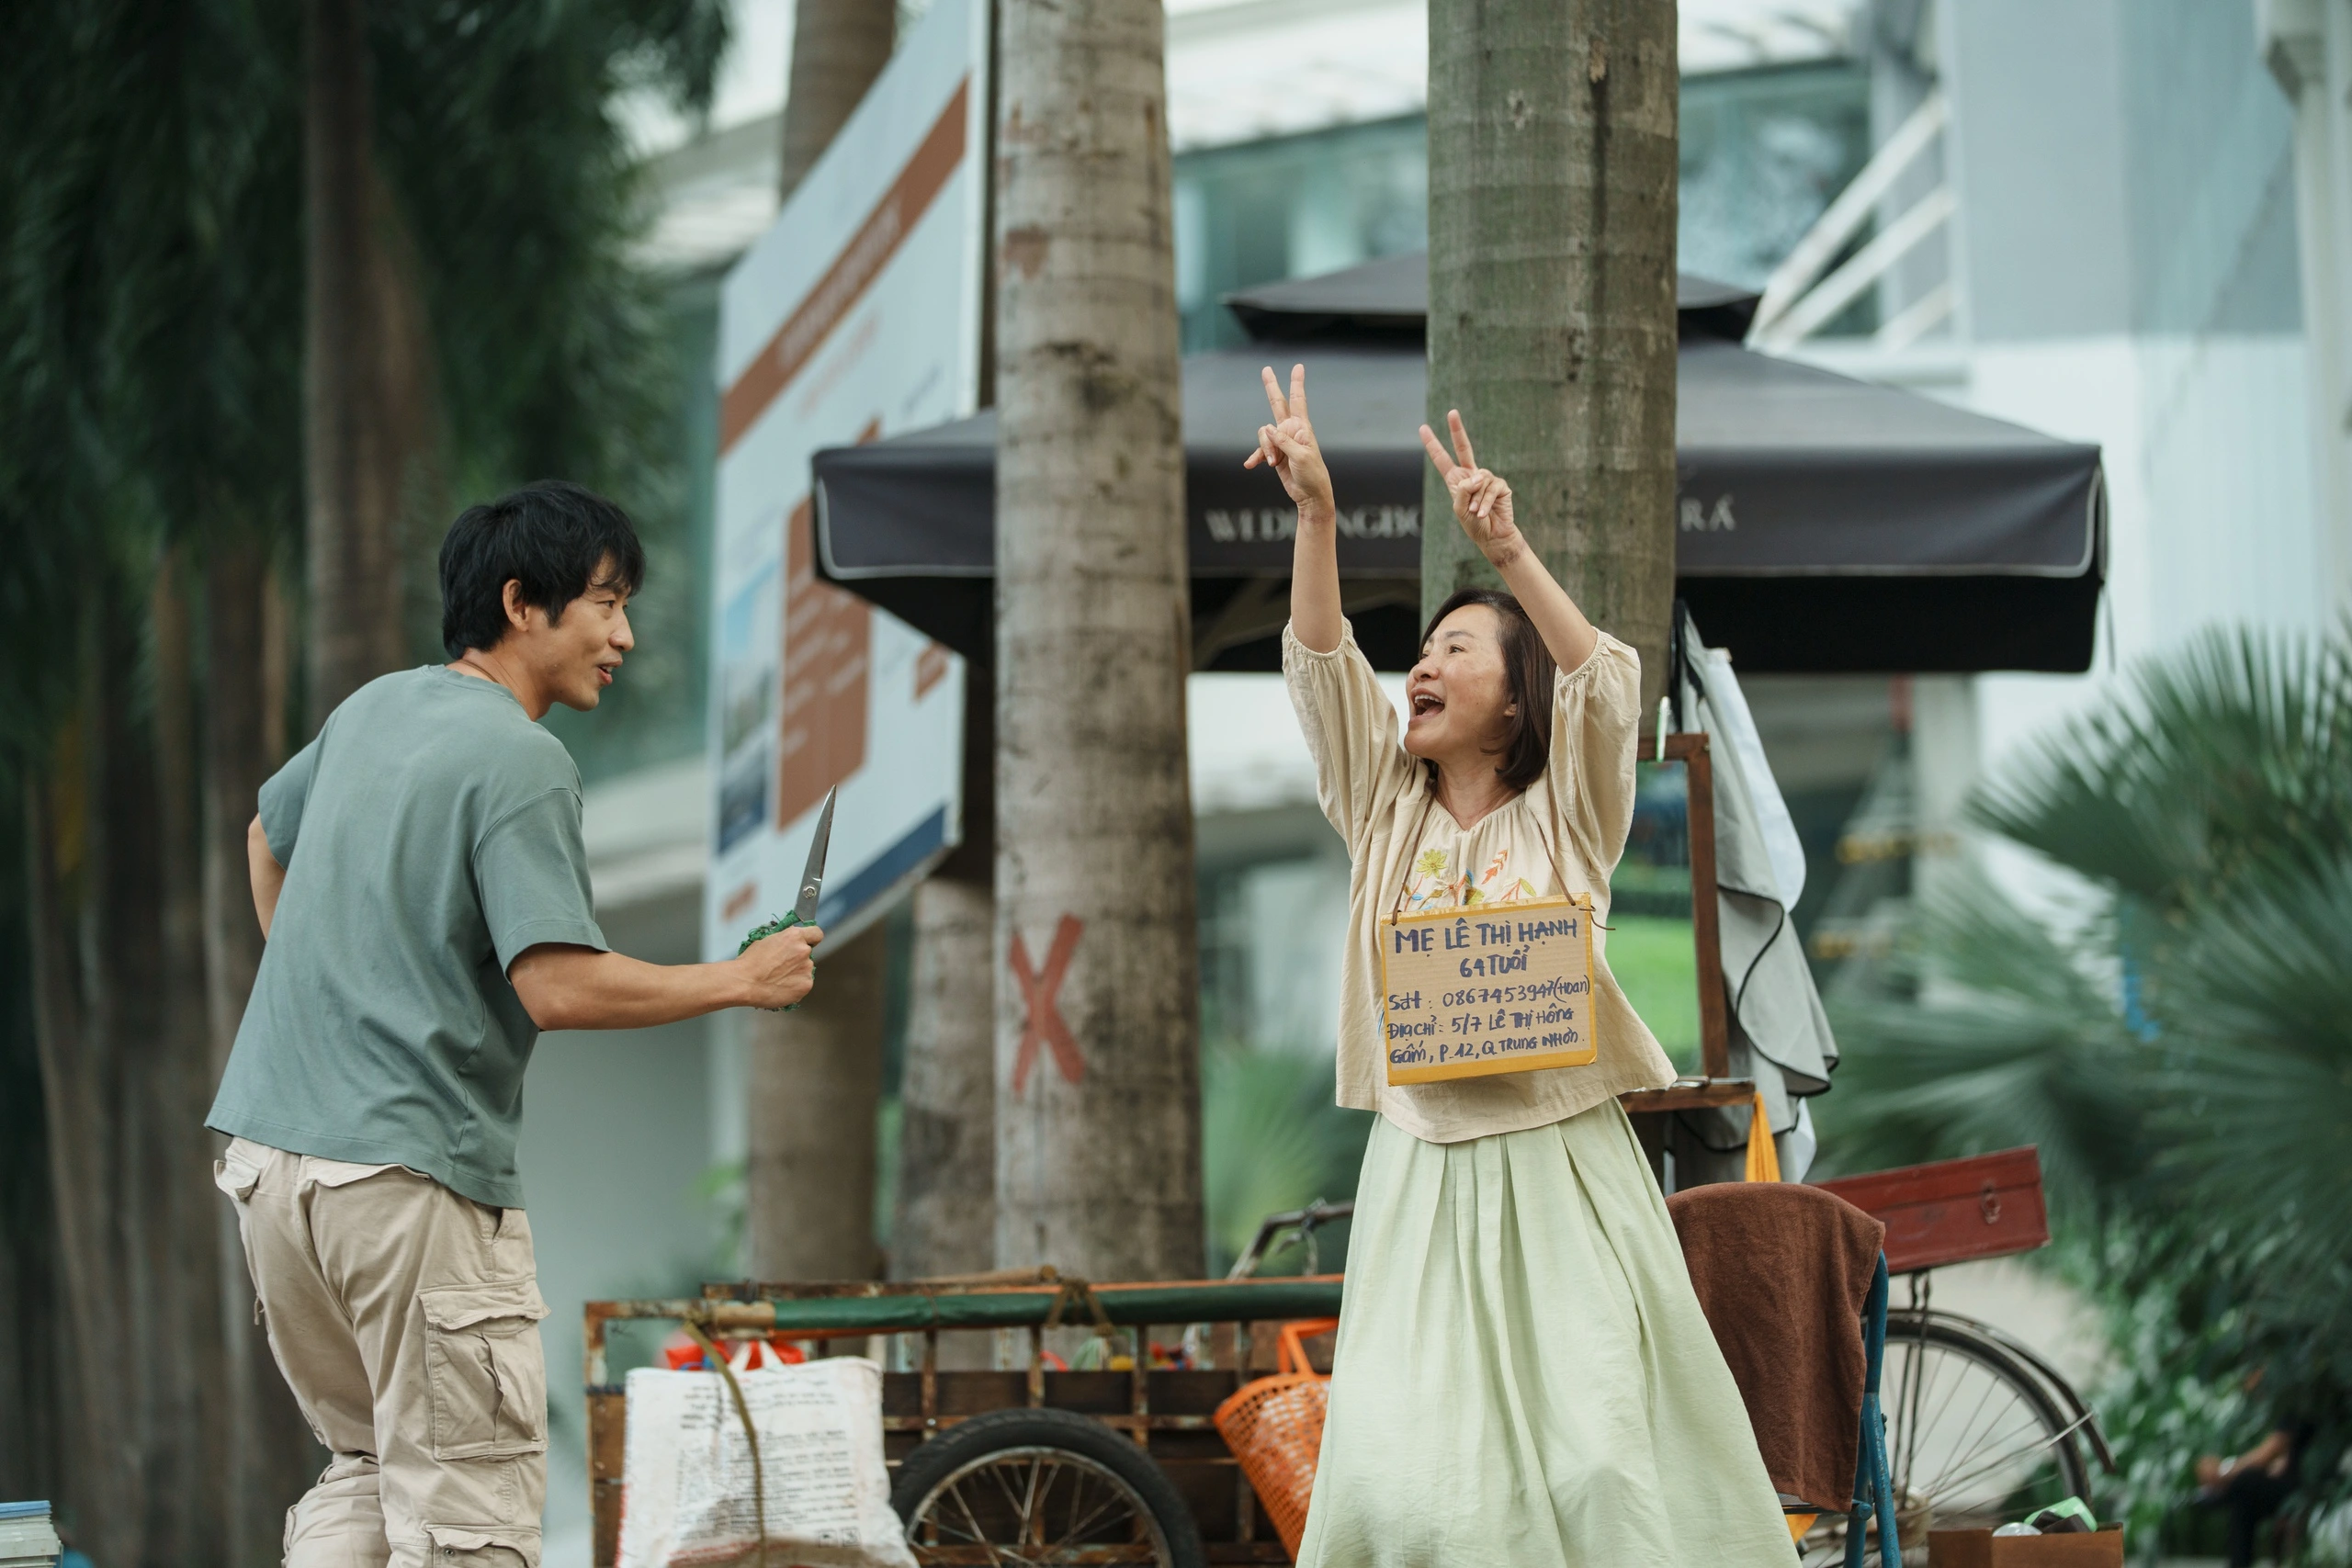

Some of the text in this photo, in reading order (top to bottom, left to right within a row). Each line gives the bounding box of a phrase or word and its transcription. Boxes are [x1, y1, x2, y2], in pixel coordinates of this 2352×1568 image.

[1396, 917, 1577, 957] MẸ LÊ THỊ HẠNH
[1452, 1012, 1482, 1035] 5/7
